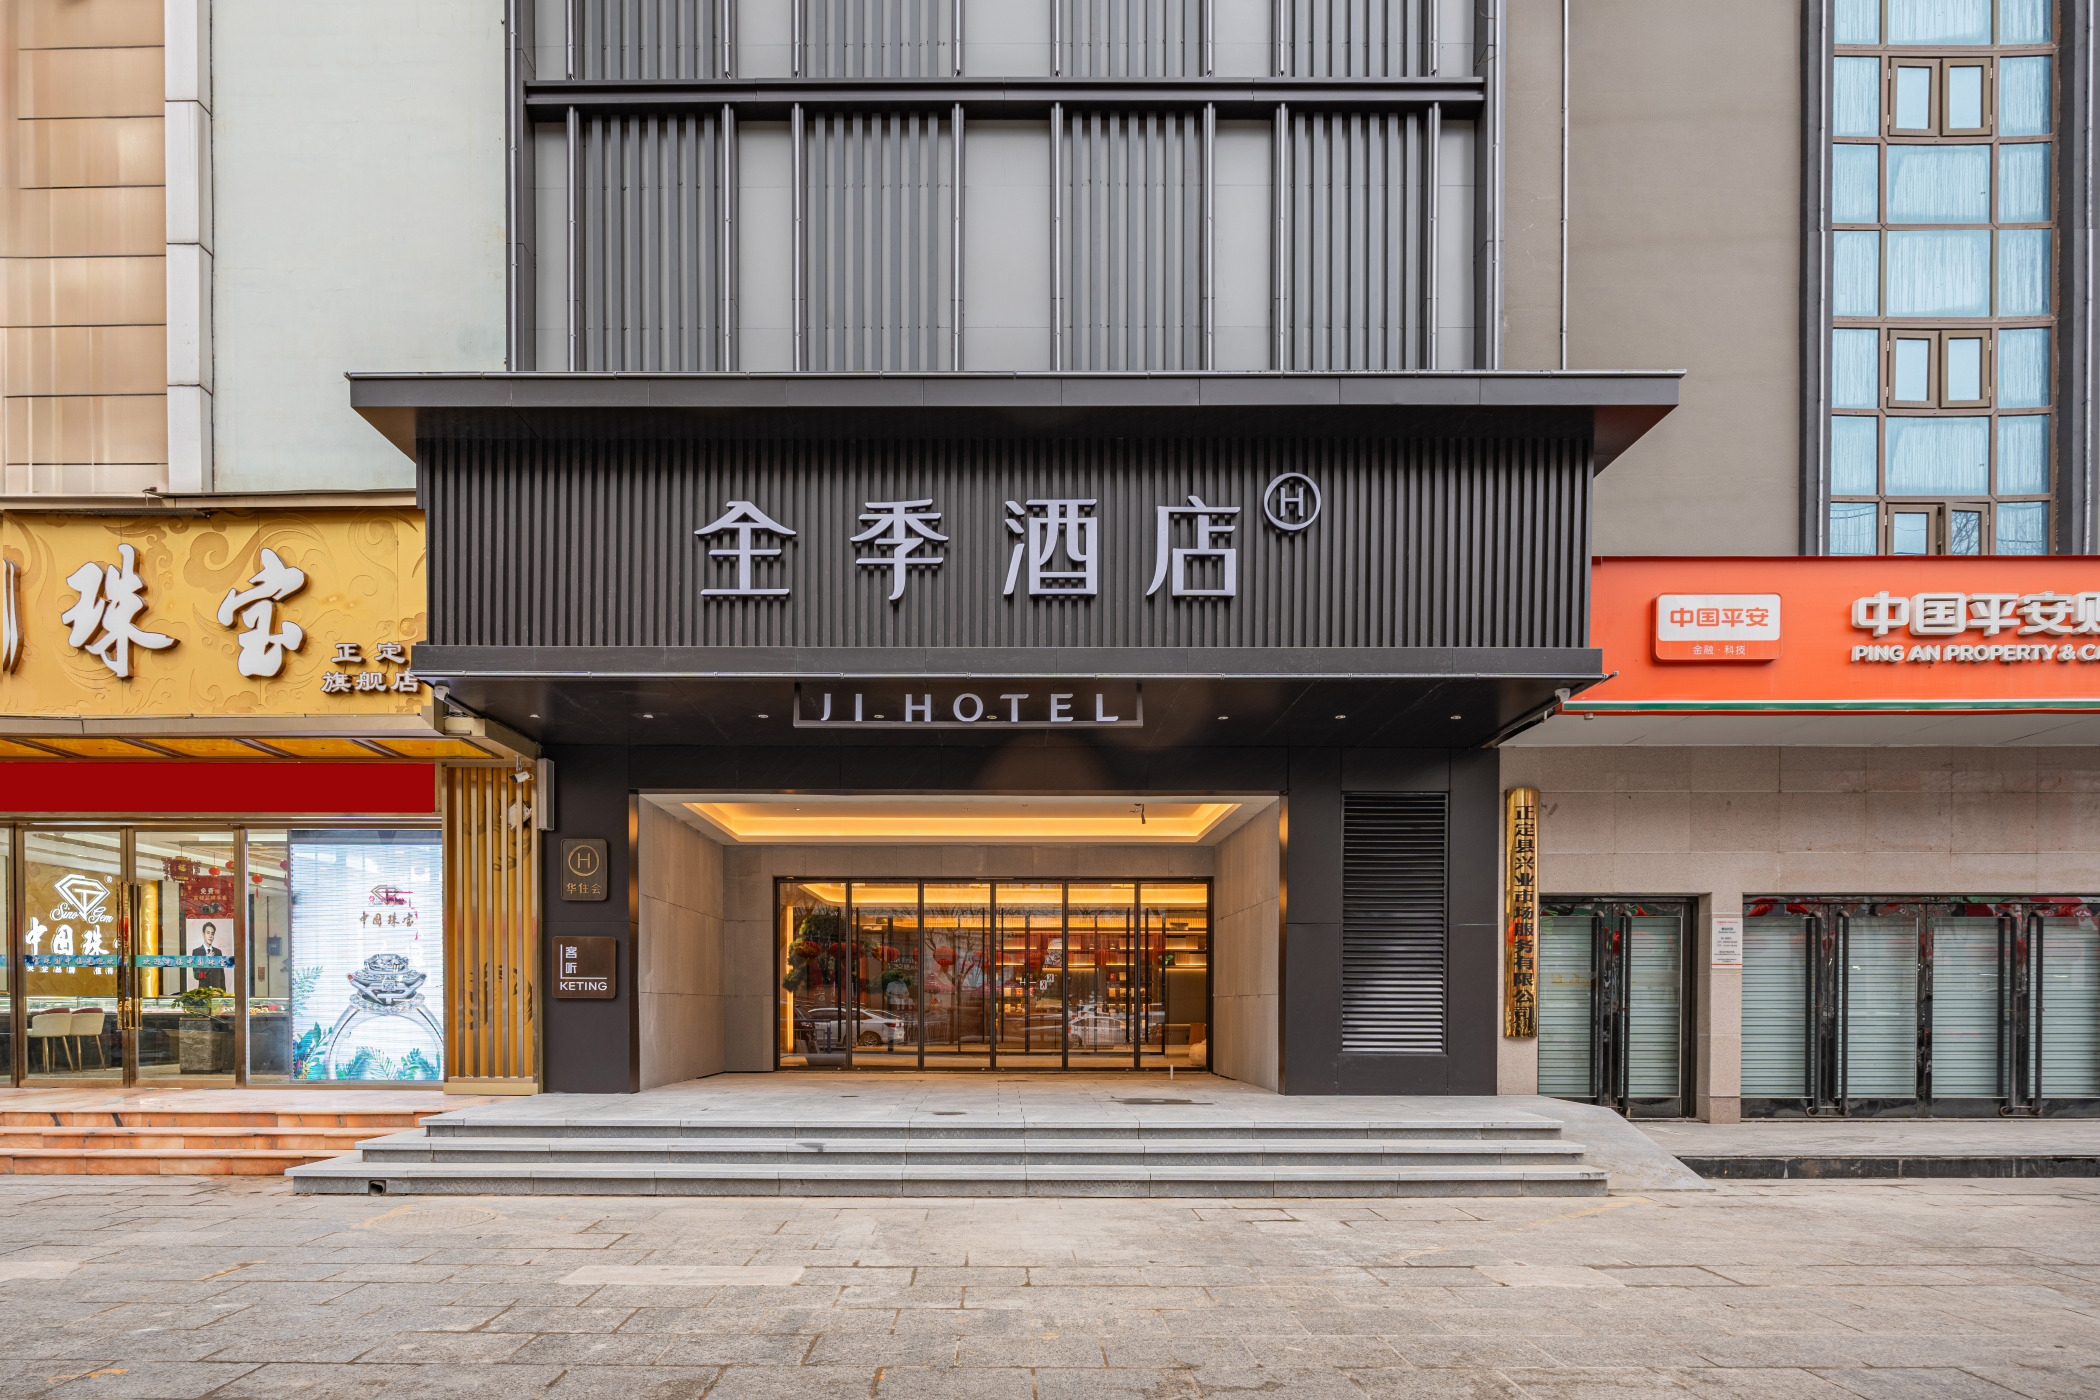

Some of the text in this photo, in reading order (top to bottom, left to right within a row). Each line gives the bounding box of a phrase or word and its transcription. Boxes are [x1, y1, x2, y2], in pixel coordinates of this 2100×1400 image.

[693, 495, 1241, 601] 全季酒店
[2, 543, 308, 678] 珠宝
[1670, 607, 1770, 628] 中国平安
[330, 641, 408, 665] 正定
[1851, 644, 1905, 663] PING
[1906, 644, 1941, 663] AN
[1942, 644, 2058, 663] PROPERTY
[2058, 643, 2076, 662] &
[319, 668, 421, 694] 旗舰店
[820, 693, 1120, 723] JI HOTEL
[566, 882, 602, 895] 华住会
[50, 902, 114, 924] Sino Gem
[359, 911, 414, 928] 中国珠宝
[1514, 805, 1535, 1022] 正定县兴业市场服务有限公司
[25, 917, 118, 956] 中国珠
[559, 981, 608, 991] KETING
